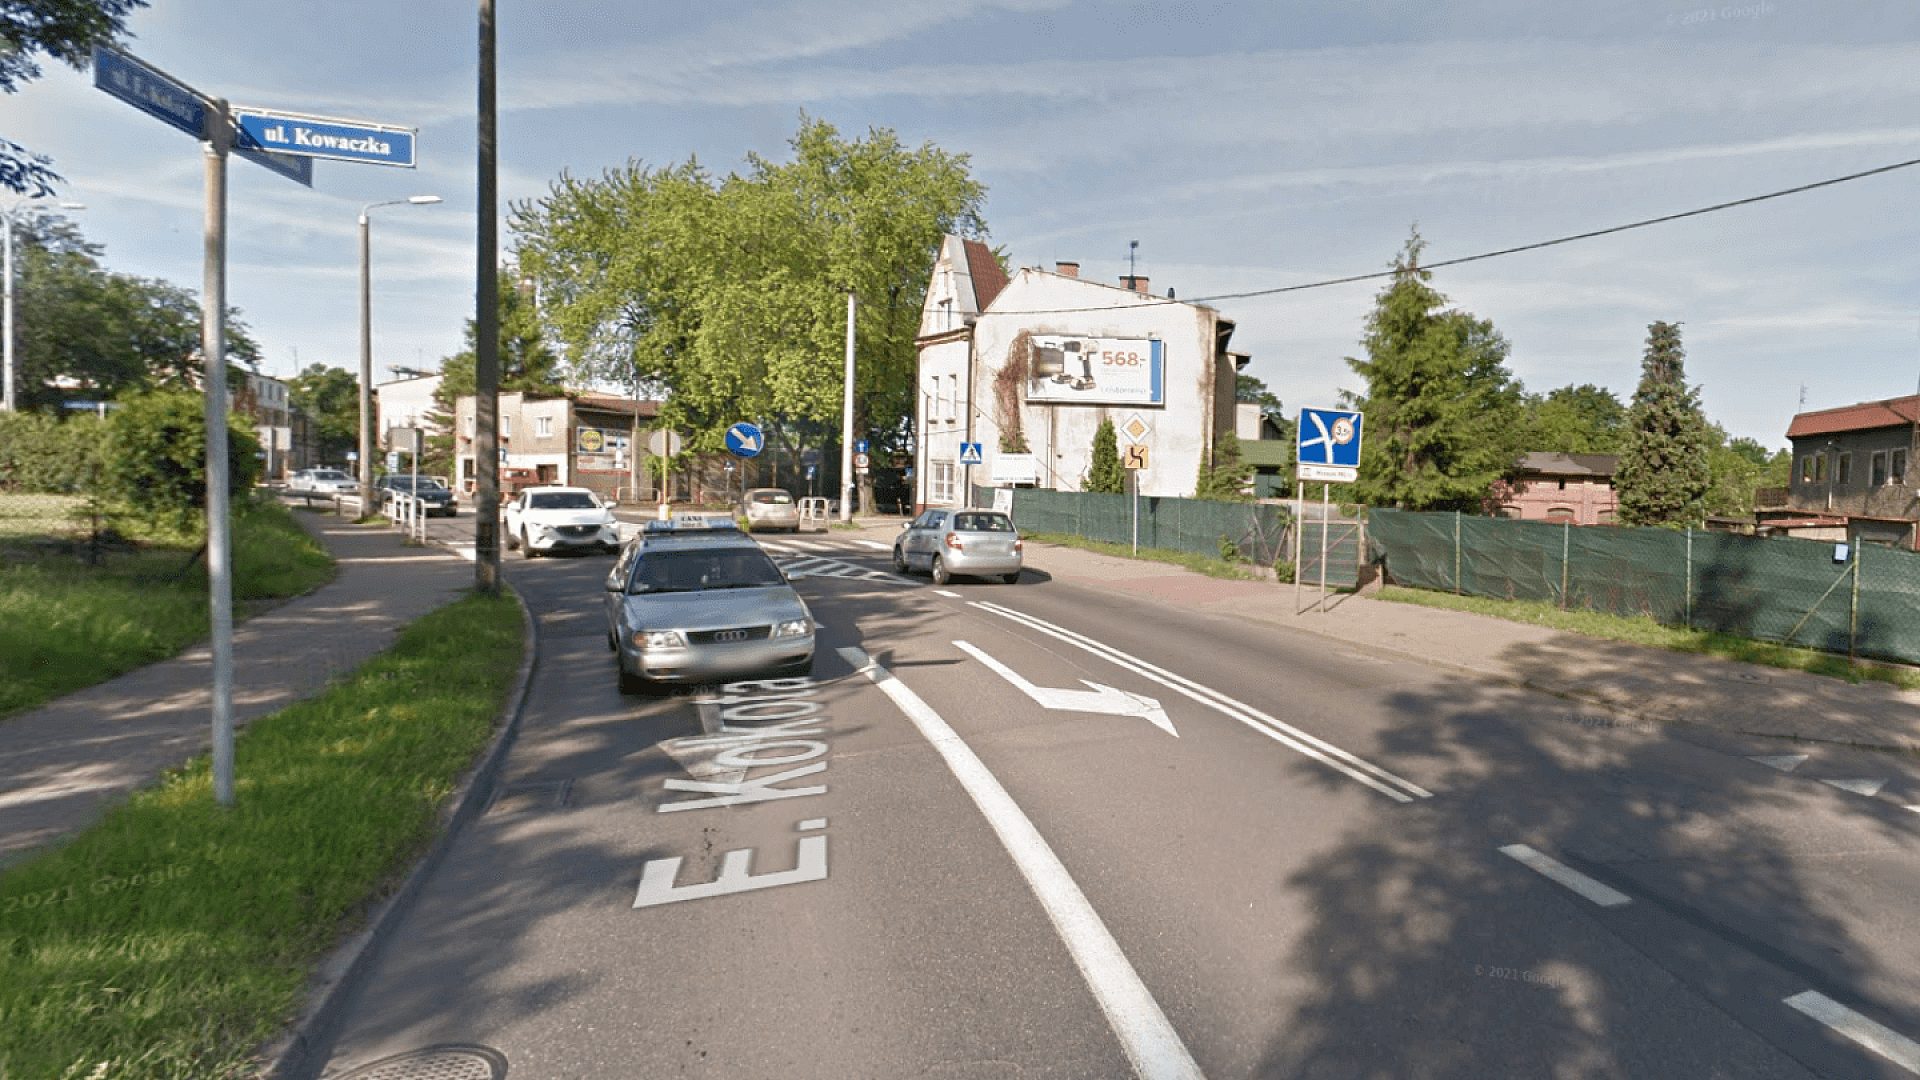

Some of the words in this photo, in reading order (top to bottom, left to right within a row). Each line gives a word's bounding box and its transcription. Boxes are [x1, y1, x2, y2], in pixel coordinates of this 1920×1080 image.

[264, 125, 289, 145] ul.
[294, 126, 392, 156] Kowaczka
[631, 817, 828, 909] E.
